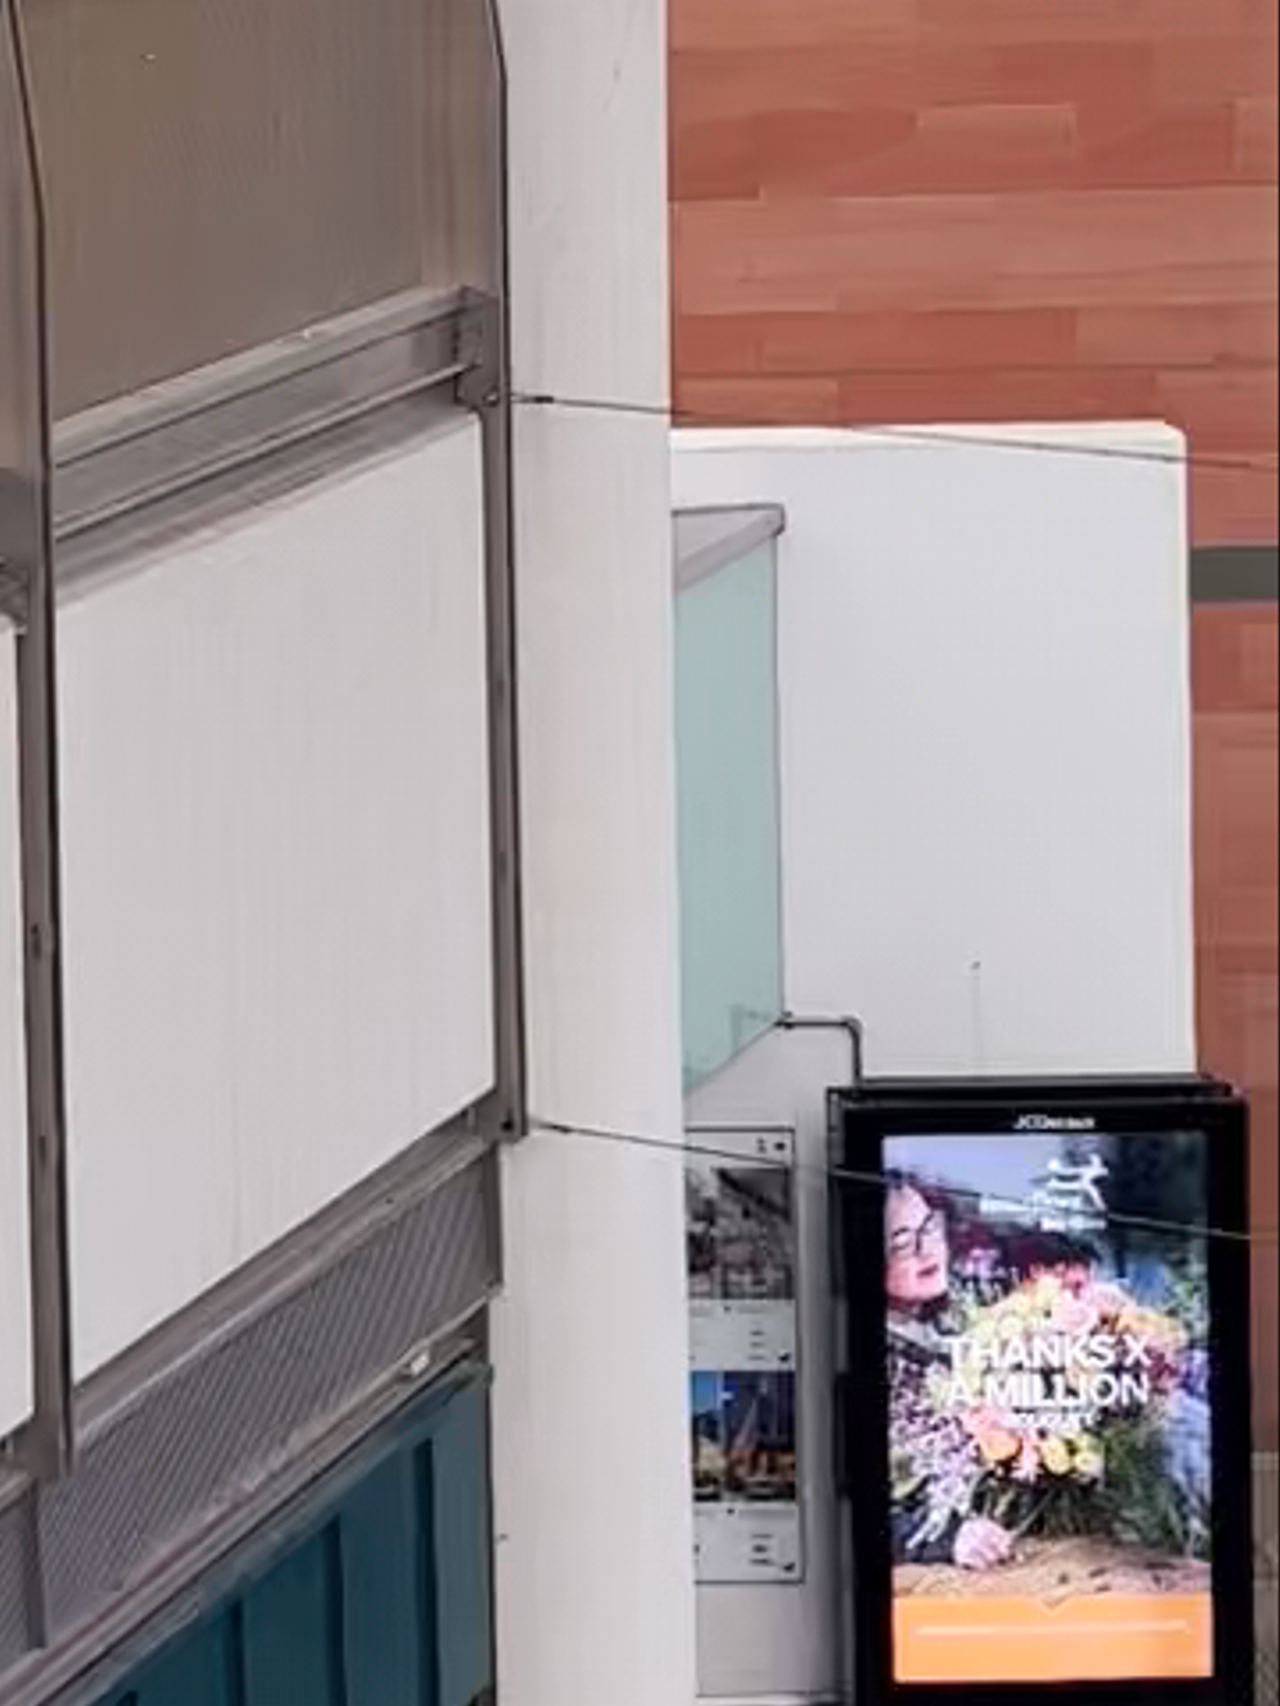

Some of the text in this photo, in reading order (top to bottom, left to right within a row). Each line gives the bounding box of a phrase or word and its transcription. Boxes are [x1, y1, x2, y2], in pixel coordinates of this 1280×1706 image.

[941, 1335, 1152, 1369] THANKS X
[947, 1373, 1150, 1407] A MILLION
